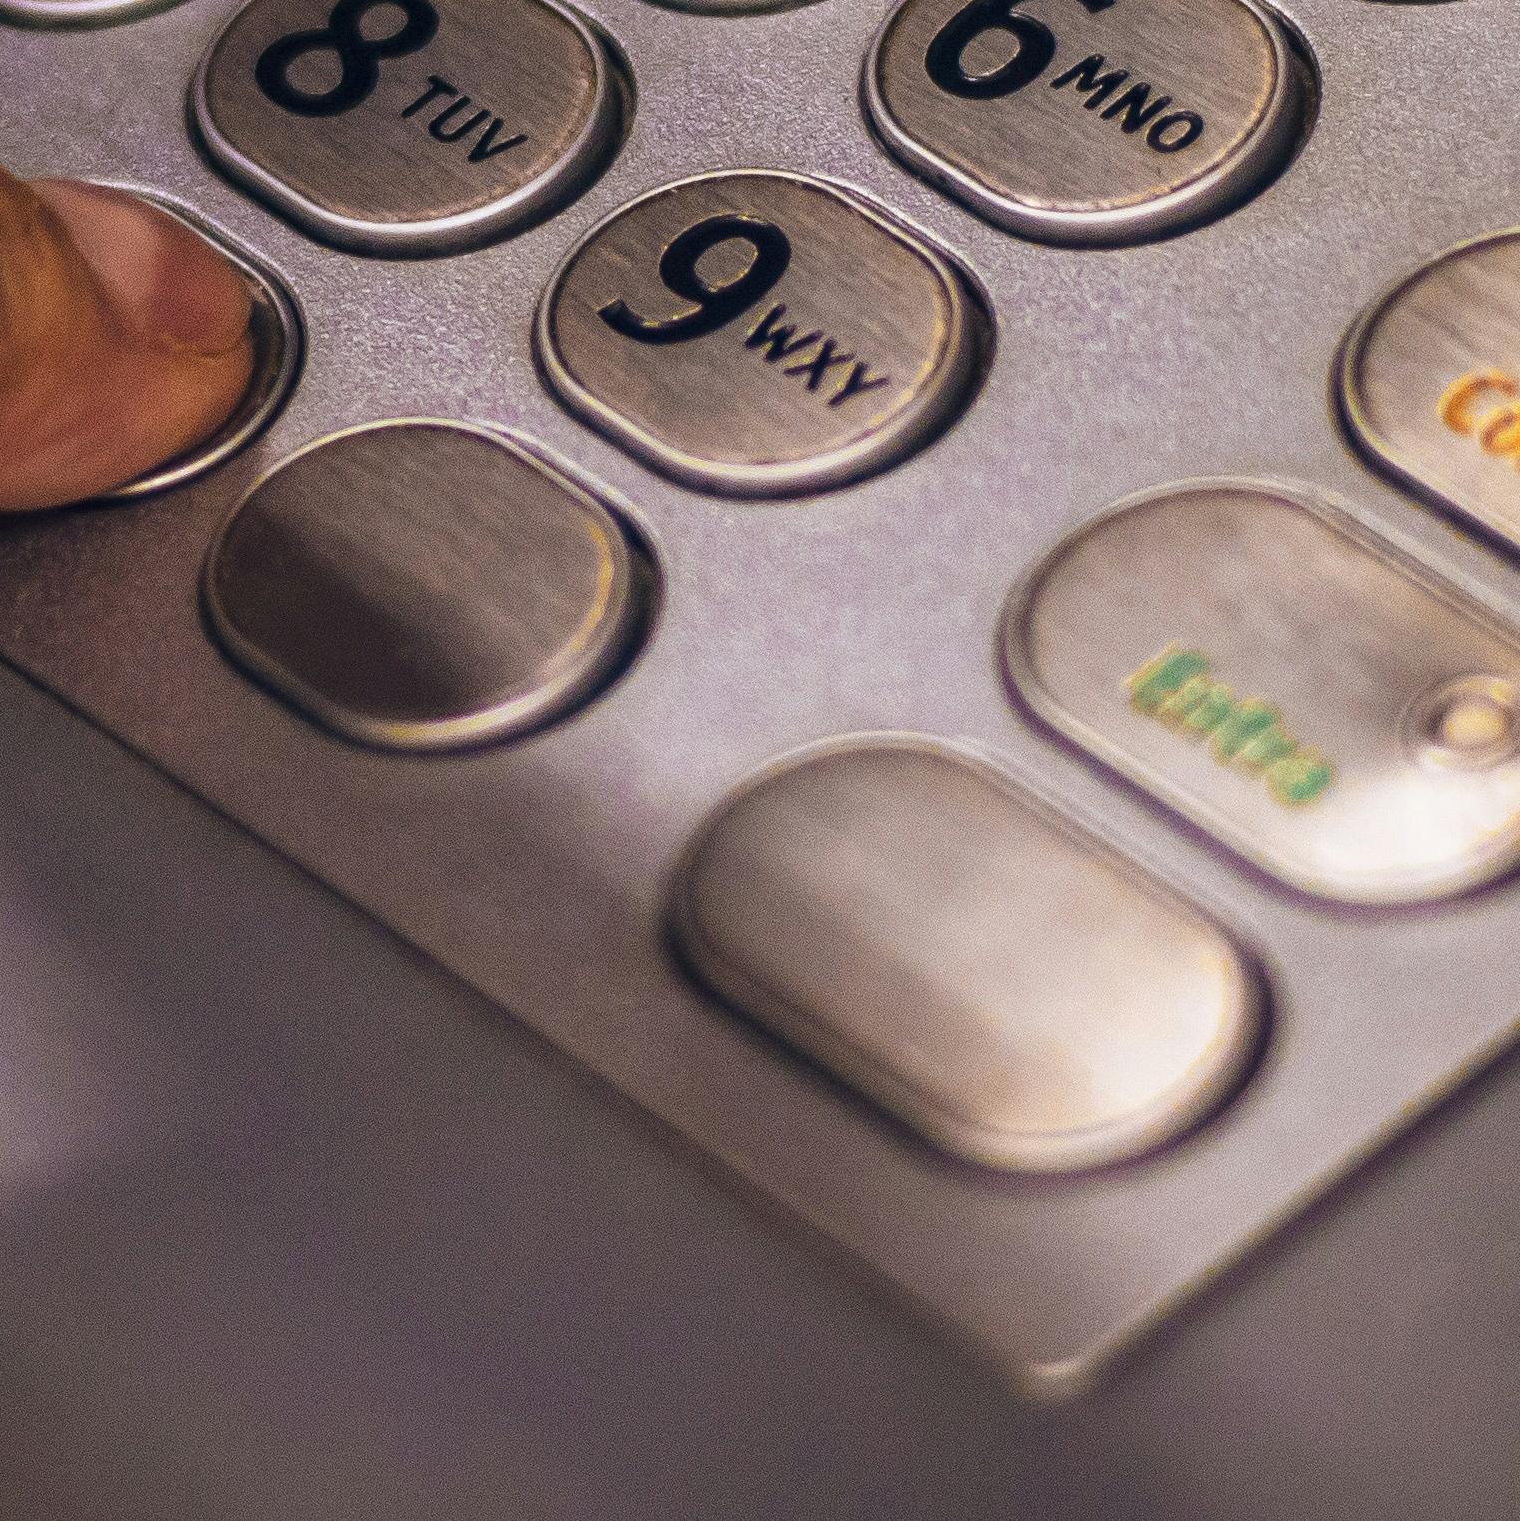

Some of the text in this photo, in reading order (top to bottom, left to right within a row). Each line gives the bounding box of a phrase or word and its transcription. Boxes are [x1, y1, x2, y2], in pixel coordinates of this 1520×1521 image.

[401, 76, 528, 163] TUV
[1050, 53, 1205, 153] MNO
[597, 213, 890, 407] 9 WXY
[1128, 647, 1335, 807] Entra
